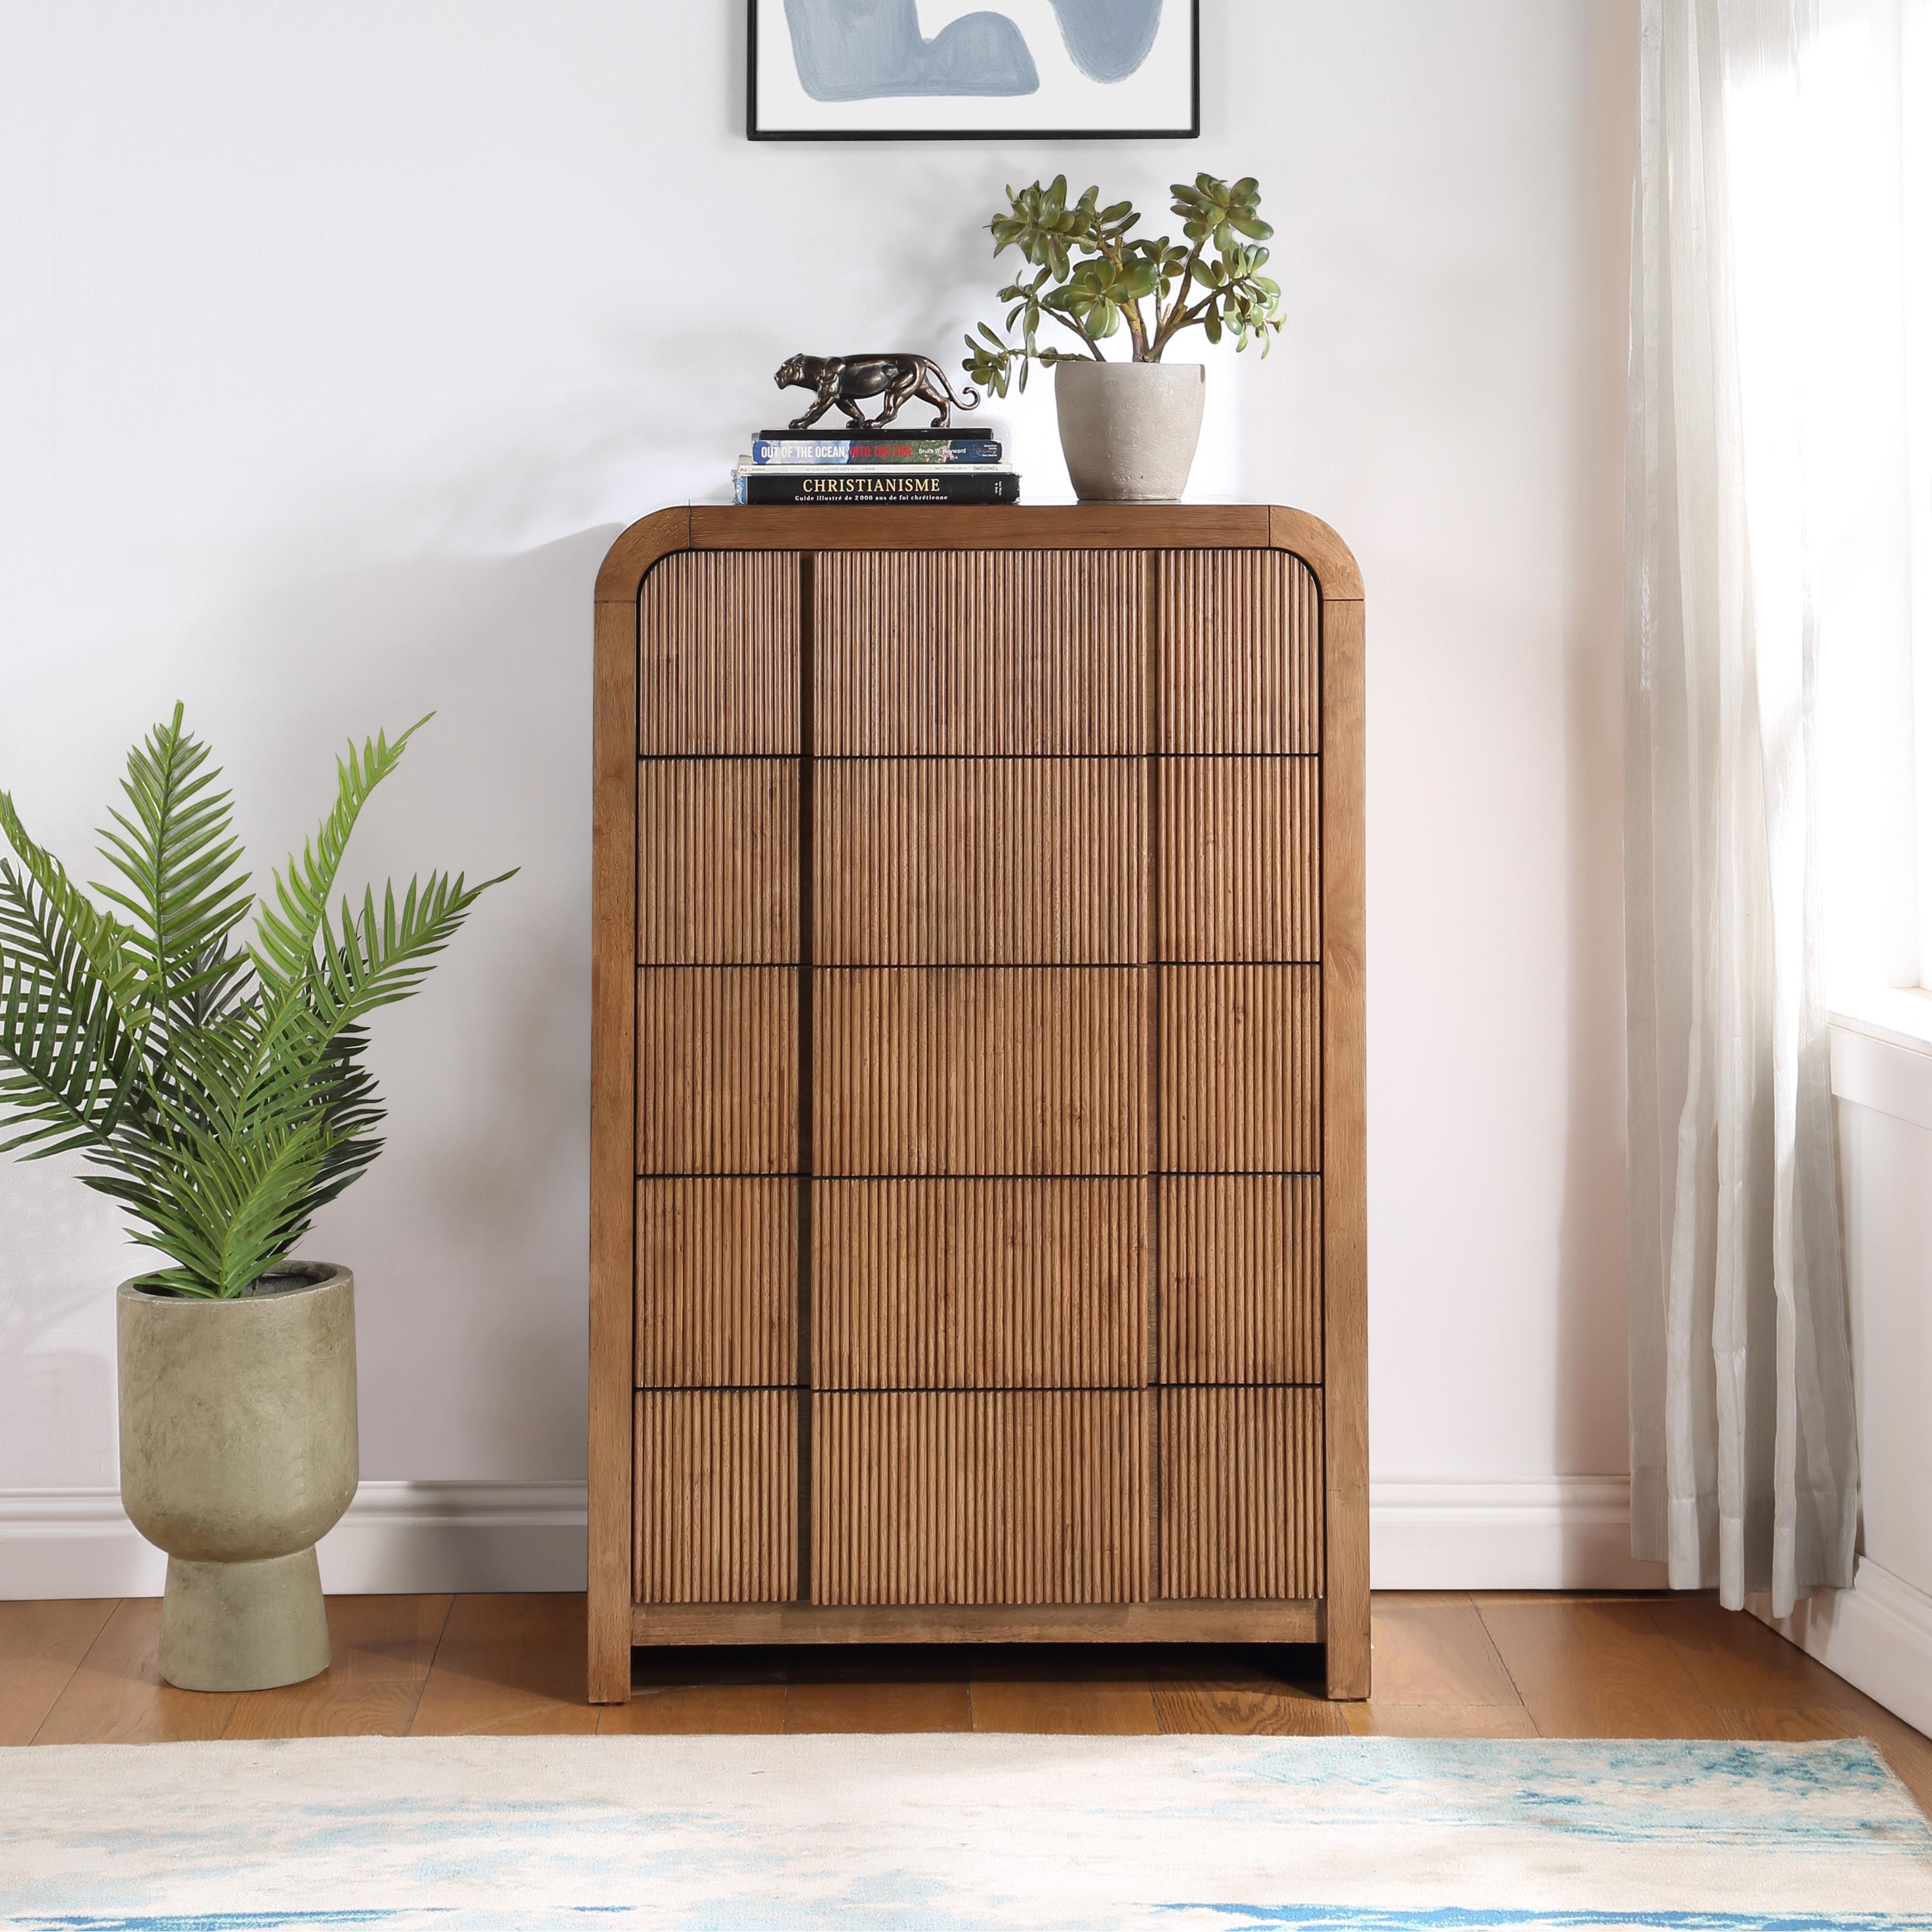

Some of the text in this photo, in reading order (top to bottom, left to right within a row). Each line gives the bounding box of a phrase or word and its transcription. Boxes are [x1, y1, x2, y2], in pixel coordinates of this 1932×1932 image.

[761, 445, 913, 459] OUT OF THE OCEAN, INTO THE FIRE
[802, 478, 940, 493] CHRISTIANISME
